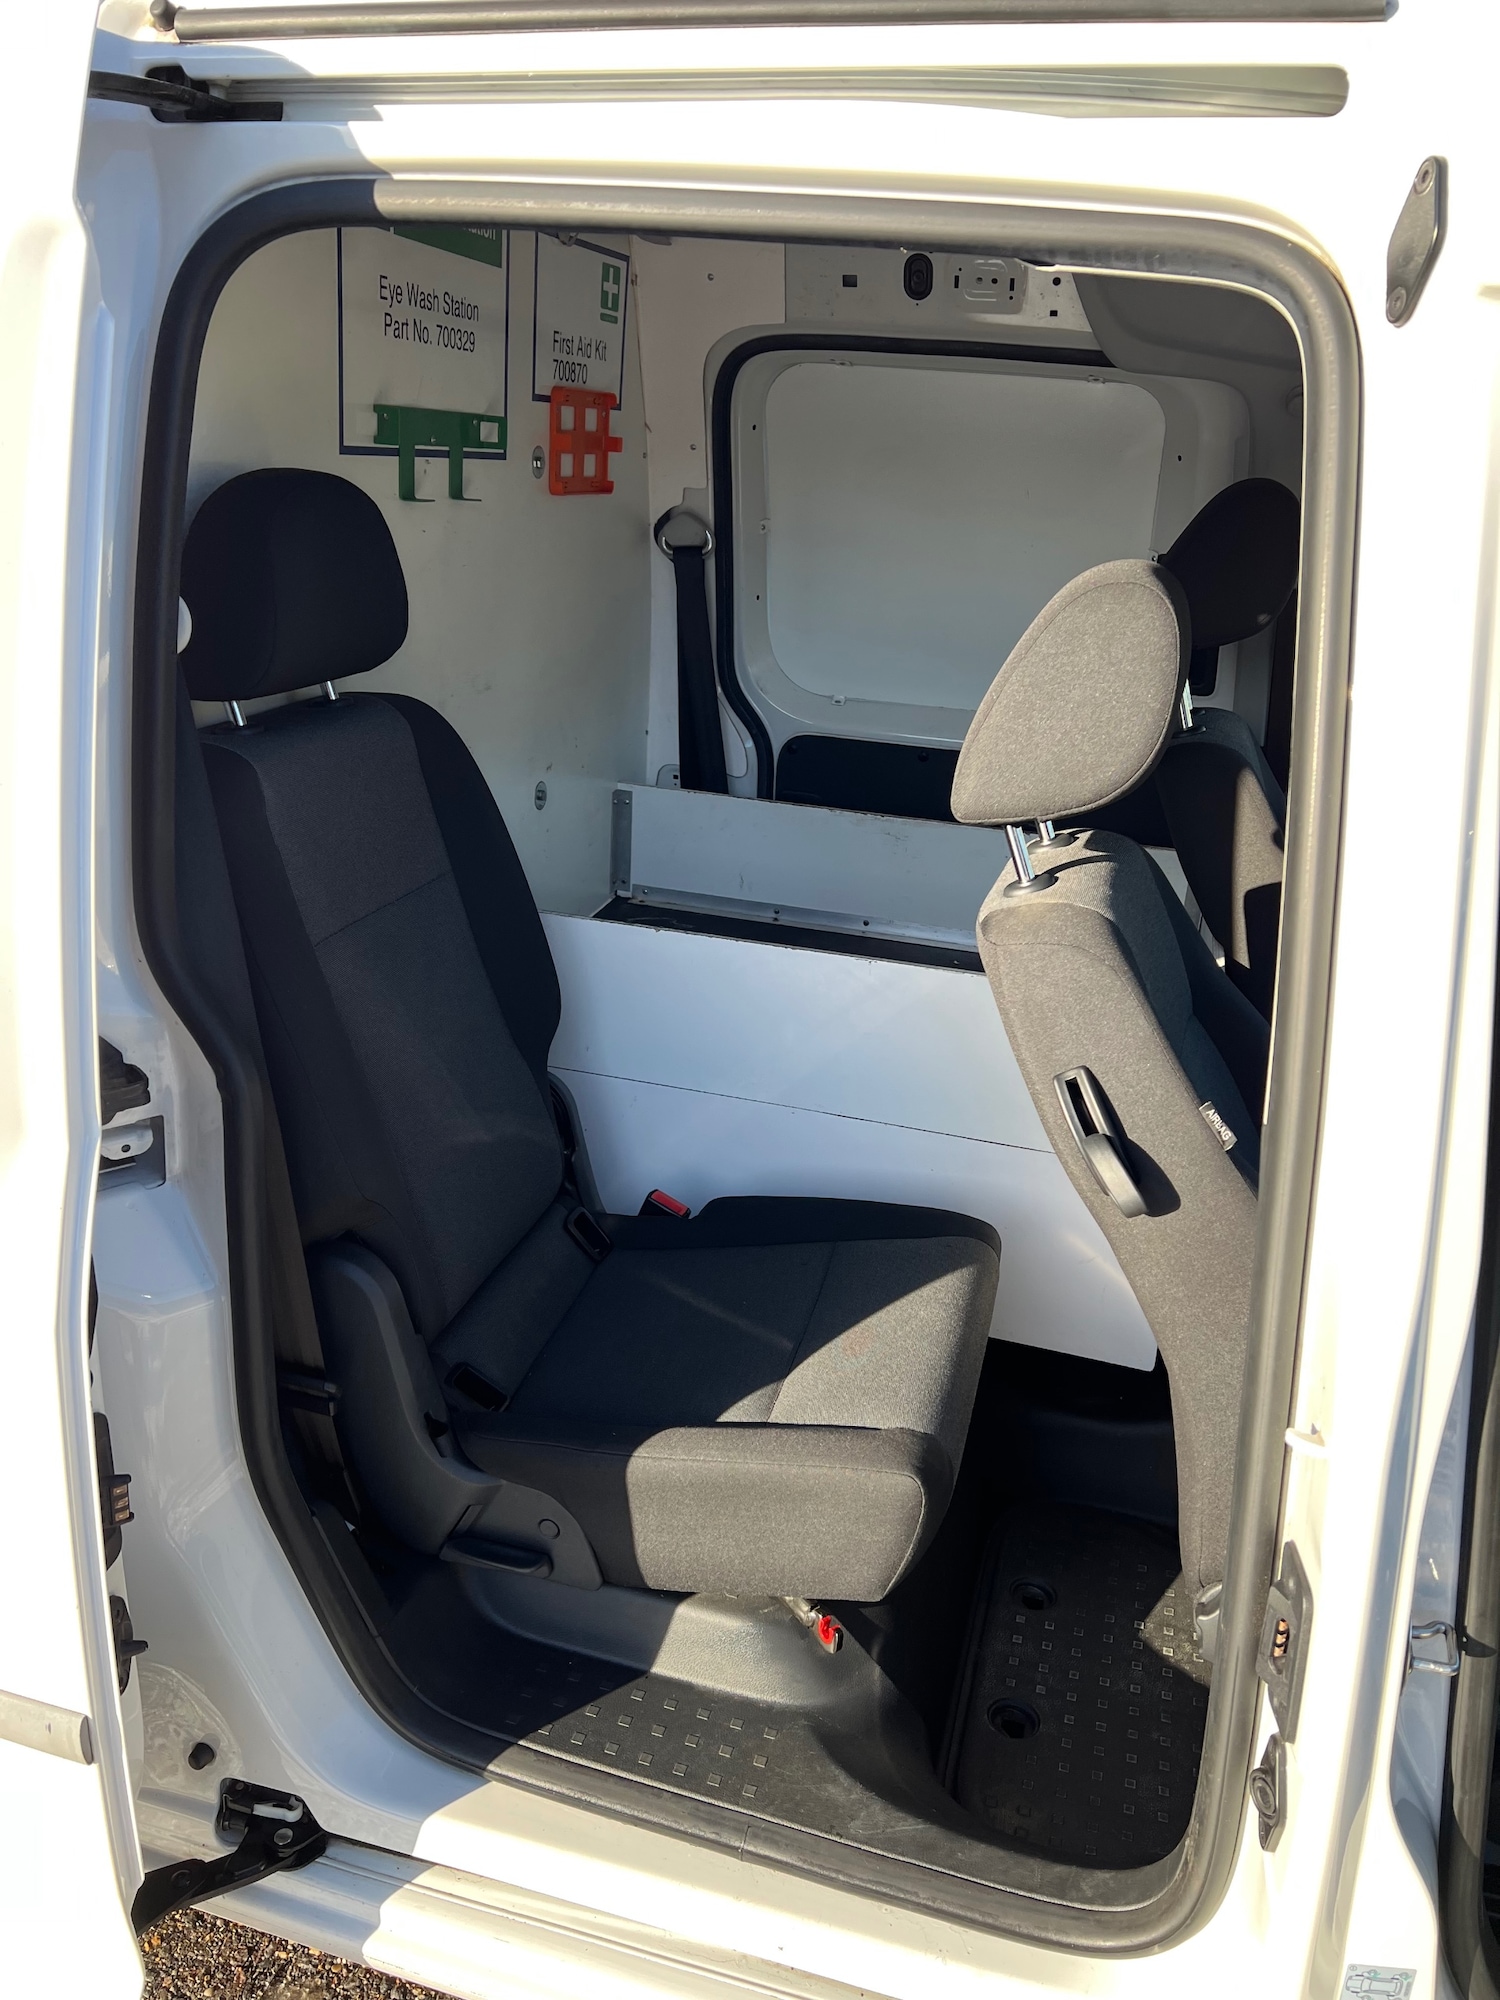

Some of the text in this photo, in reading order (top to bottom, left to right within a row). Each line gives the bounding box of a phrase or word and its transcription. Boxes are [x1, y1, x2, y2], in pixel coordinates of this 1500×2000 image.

[379, 274, 479, 322] Eye Wash Station
[384, 312, 476, 353] Part No. 700329
[552, 330, 607, 362] First Aid Kit
[552, 359, 588, 385] 700870
[1206, 1109, 1232, 1141] AIRBAG
